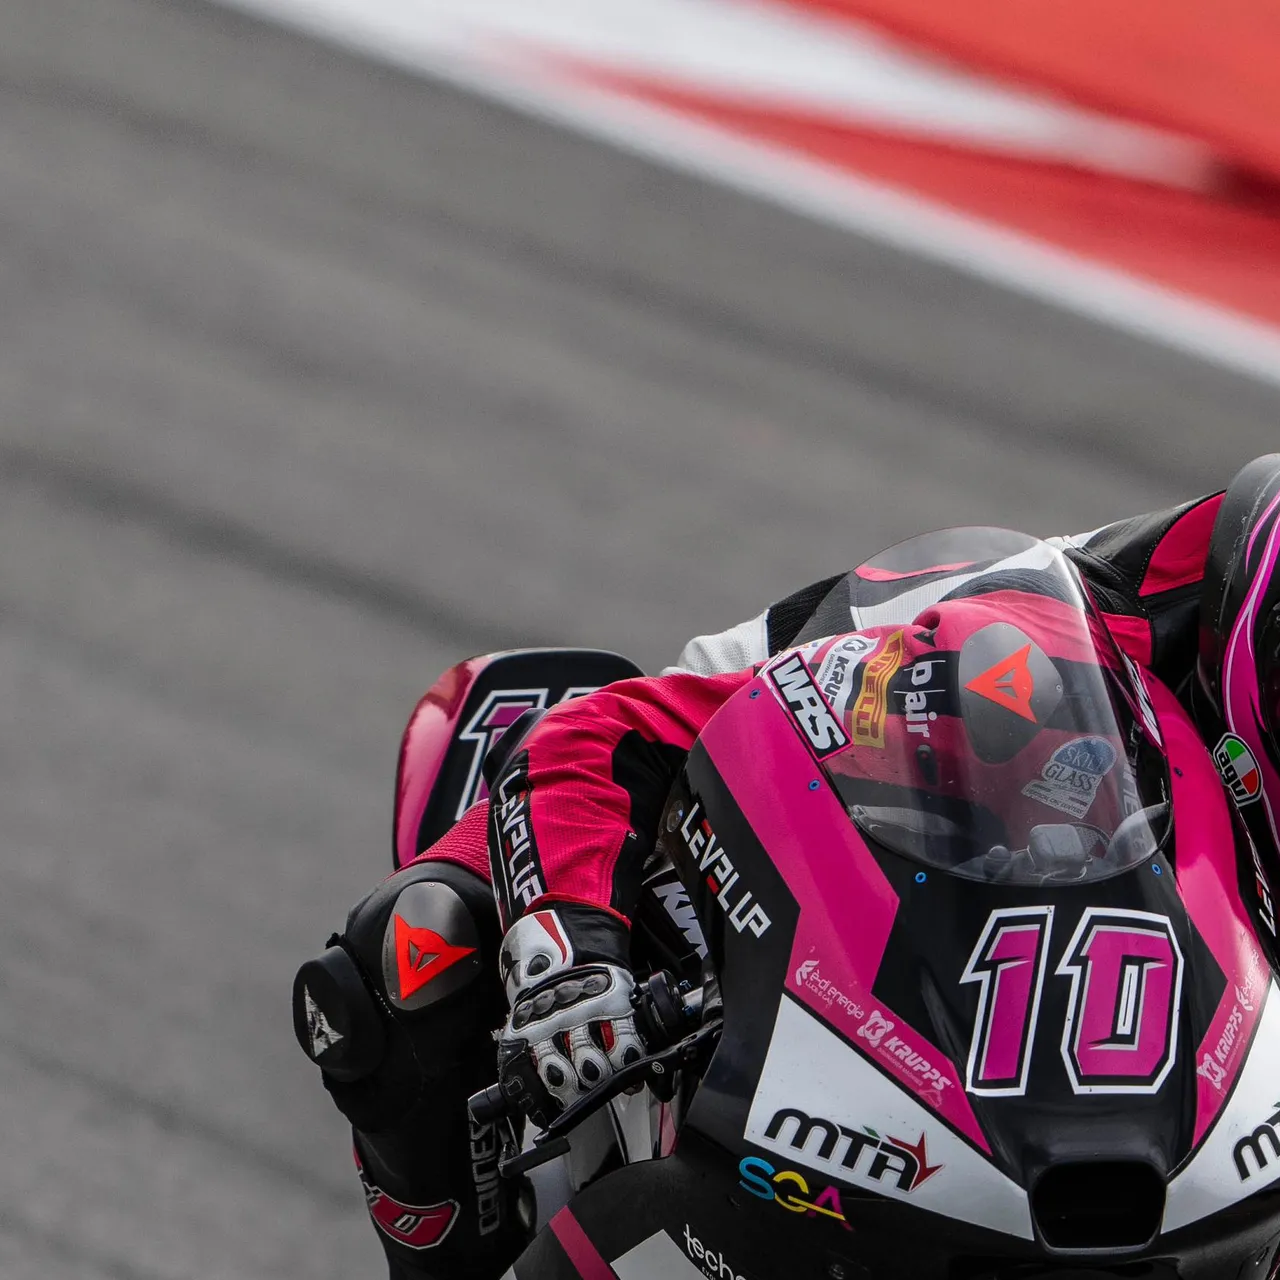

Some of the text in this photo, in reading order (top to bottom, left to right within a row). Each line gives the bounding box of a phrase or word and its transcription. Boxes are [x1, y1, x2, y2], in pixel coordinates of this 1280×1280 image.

[772, 659, 846, 750] WRS
[1044, 763, 1097, 792] GLASS
[1218, 750, 1247, 798] agv
[680, 802, 772, 939] LEVELUP
[958, 904, 1185, 1097] 10
[884, 1036, 952, 1091] KRUPPS
[1214, 1005, 1243, 1064] KRUPPS
